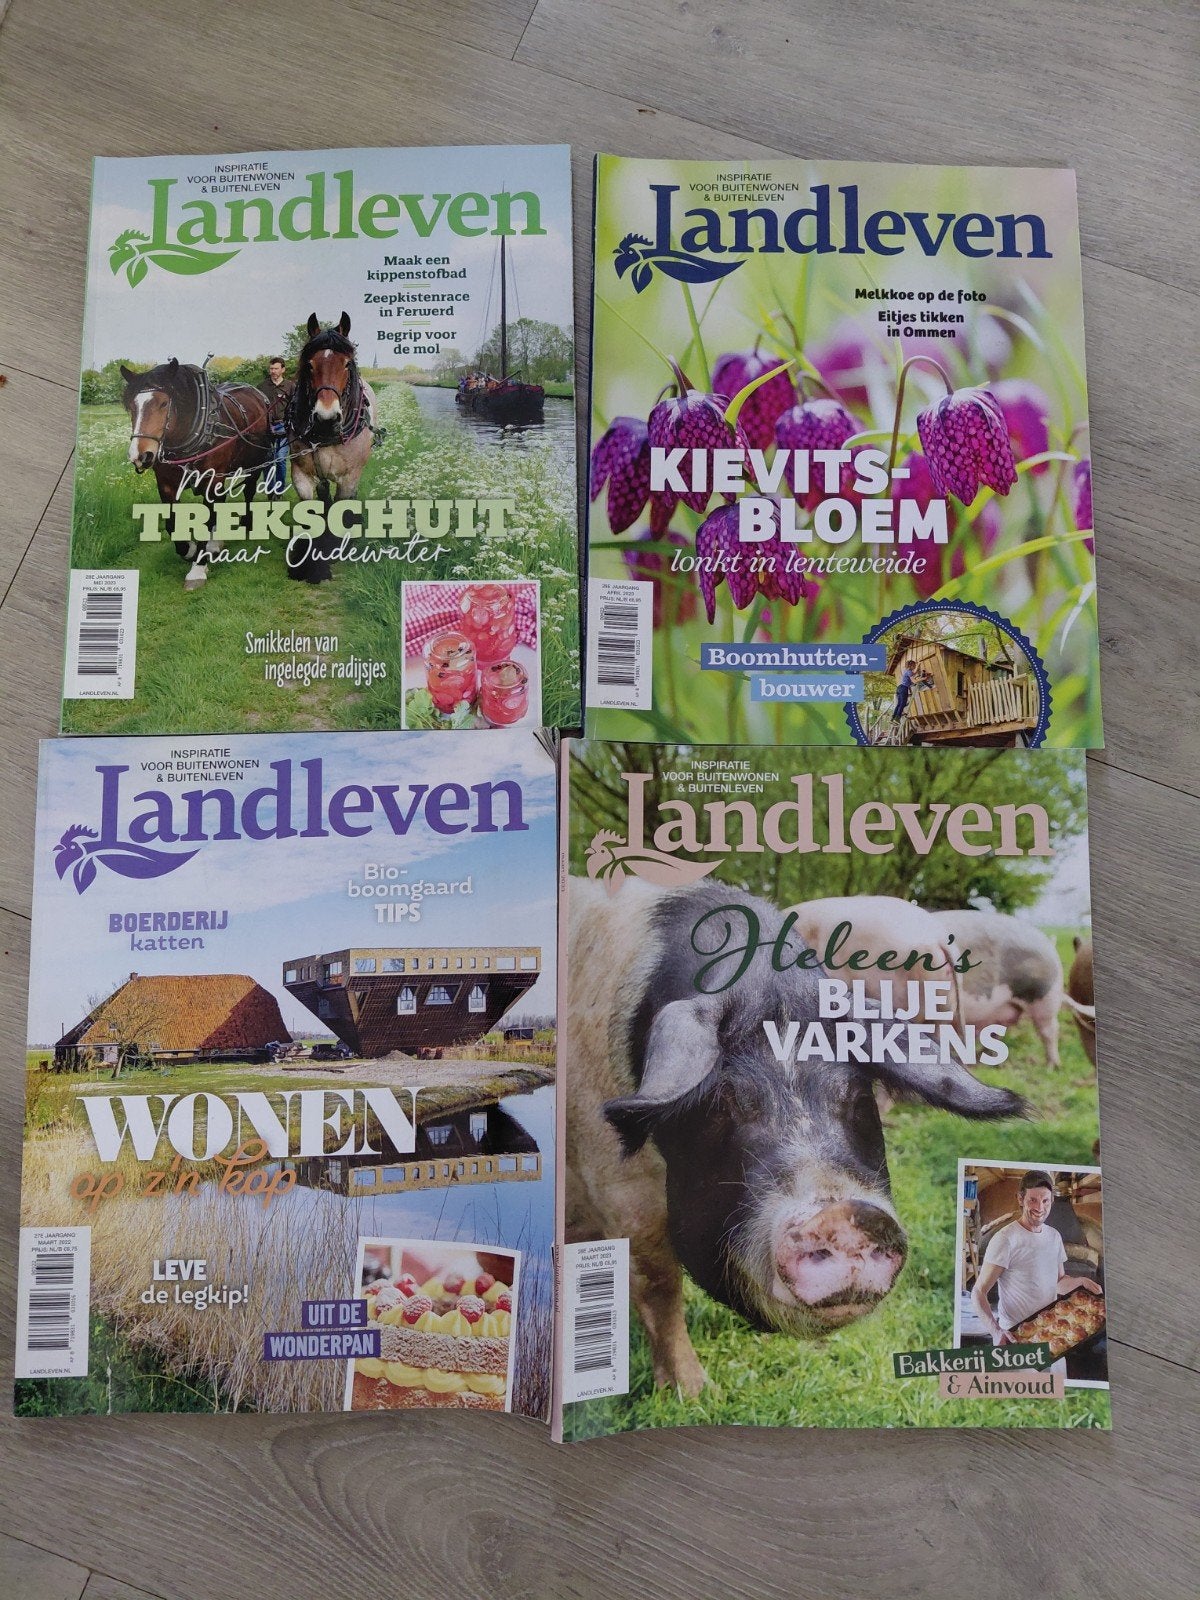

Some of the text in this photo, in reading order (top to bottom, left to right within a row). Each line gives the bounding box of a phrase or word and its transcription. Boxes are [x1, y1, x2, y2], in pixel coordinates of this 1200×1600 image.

[214, 162, 269, 173] INSPIRATIE
[716, 173, 772, 182] INSPIRATIE
[187, 172, 295, 184] VOOR BUITENWONEN
[689, 183, 799, 192] VOOR BUITENWONEN
[200, 183, 281, 194] & BUITENLEVEN
[703, 193, 785, 202] & BUITENLEVEN
[147, 169, 547, 247] Landleven
[649, 184, 1053, 259] Landleven
[384, 255, 451, 266] Maak een
[367, 268, 467, 282] kippenstofbad
[364, 292, 470, 305] Zeepkistenrace
[854, 288, 987, 304] Melkkoe op de foto
[379, 306, 454, 317] in Ferwerd
[878, 310, 965, 325] Eitjes tikken
[377, 330, 457, 342] Begrip voor
[887, 325, 956, 338] in Ommen
[393, 343, 440, 354] de mol
[650, 447, 911, 495] KIEVITS-
[175, 466, 293, 503] Met de
[132, 499, 517, 542] TREKSCHUIT
[739, 497, 949, 544] BLOEM
[196, 532, 452, 568] naar Oudewater
[670, 549, 927, 574] lonkt in lenteweide
[245, 629, 338, 654] Smikkelen van
[707, 648, 879, 667] Boomhutten-
[264, 655, 387, 688] ingelegde radijsjes
[759, 678, 855, 698] bouwer
[170, 748, 231, 759] INSPIRATIE
[140, 759, 260, 771] VOOR BUITENWONEN
[691, 760, 751, 770] INSPIRATIE
[156, 772, 244, 783] & BUITENLEVEN
[662, 771, 779, 782] VOOR BUITENWONEN
[677, 783, 764, 793] & BUITENLEVEN
[95, 758, 529, 845] Landleven
[620, 773, 1055, 857] Landleven
[364, 863, 408, 881] Bio-
[347, 876, 473, 900] boomgaard
[108, 910, 229, 933] BOERDERIJ
[374, 902, 421, 923] TIPS
[129, 934, 205, 952] katten
[690, 904, 983, 995] Heleen's
[819, 978, 955, 1021] BLIJE
[763, 1020, 1010, 1066] VARKENS
[76, 1086, 426, 1162] WONEN
[69, 1138, 297, 1215] op z'n kop
[153, 1259, 207, 1281] LEVE
[141, 1284, 249, 1310] de legkip!
[308, 1303, 362, 1326] UIT DE
[270, 1333, 374, 1358] WONDERPAN
[29, 1367, 72, 1375] LANDLEVEN.NL
[899, 1347, 1046, 1375] Bakkerij Stoet
[576, 1387, 615, 1398] LANDLEVEN.NL
[946, 1374, 1055, 1395] & Ainvoud
